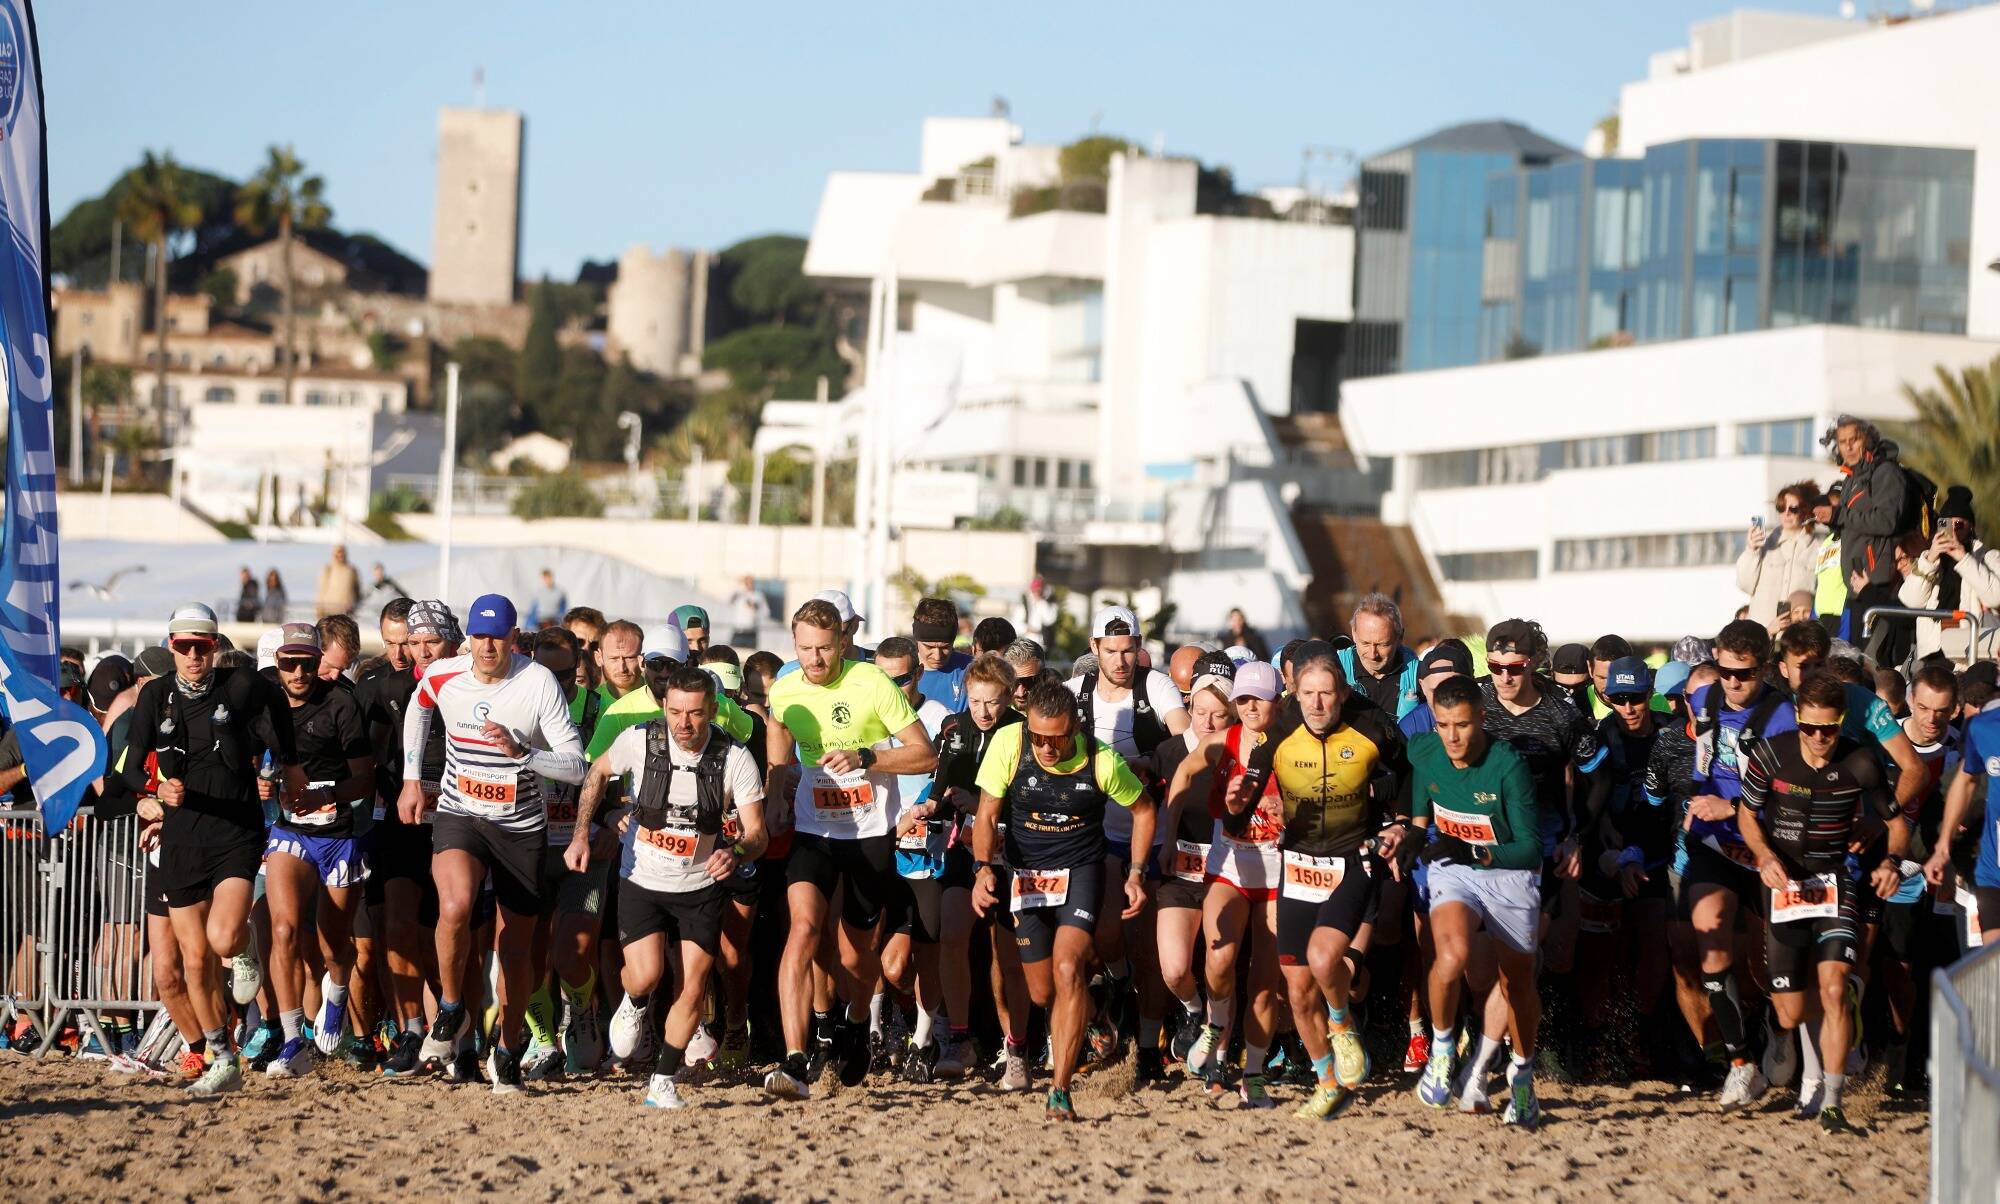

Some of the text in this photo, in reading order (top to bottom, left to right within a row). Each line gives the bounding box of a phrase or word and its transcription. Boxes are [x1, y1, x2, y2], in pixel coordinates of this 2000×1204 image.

[1209, 667, 1230, 677] RUN
[1616, 673, 1635, 681] UTMB
[1294, 760, 1318, 769] KENNY
[467, 769, 508, 780] INTERSPORT
[464, 779, 507, 801] 1488
[822, 788, 863, 807] 1191
[1286, 790, 1360, 805] Groupam
[1443, 820, 1484, 840] 1495
[645, 828, 687, 854] 1399
[1018, 876, 1060, 893] 1347
[1294, 866, 1333, 888] 1509
